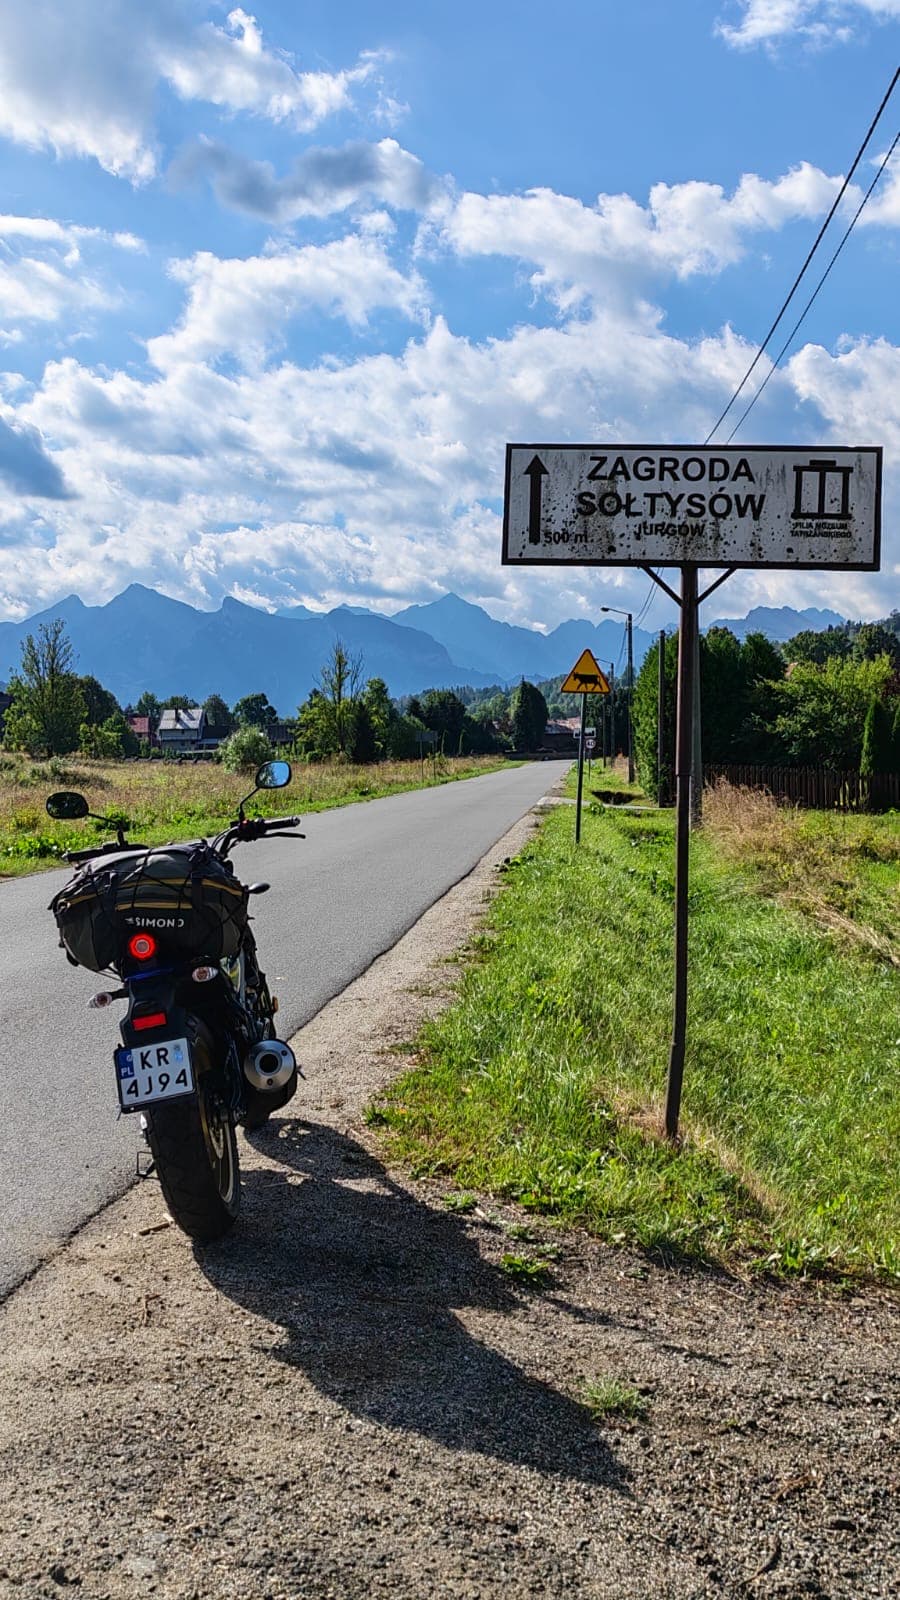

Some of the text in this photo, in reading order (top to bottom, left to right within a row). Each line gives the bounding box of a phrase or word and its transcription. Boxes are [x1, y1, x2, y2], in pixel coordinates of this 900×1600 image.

[587, 456, 755, 482] ZAGRODA
[577, 487, 766, 520] SOŁTYSÓW
[544, 531, 570, 544] 500
[140, 1047, 170, 1070] KR
[121, 1066, 134, 1077] PL
[126, 1068, 188, 1098] 4J94
